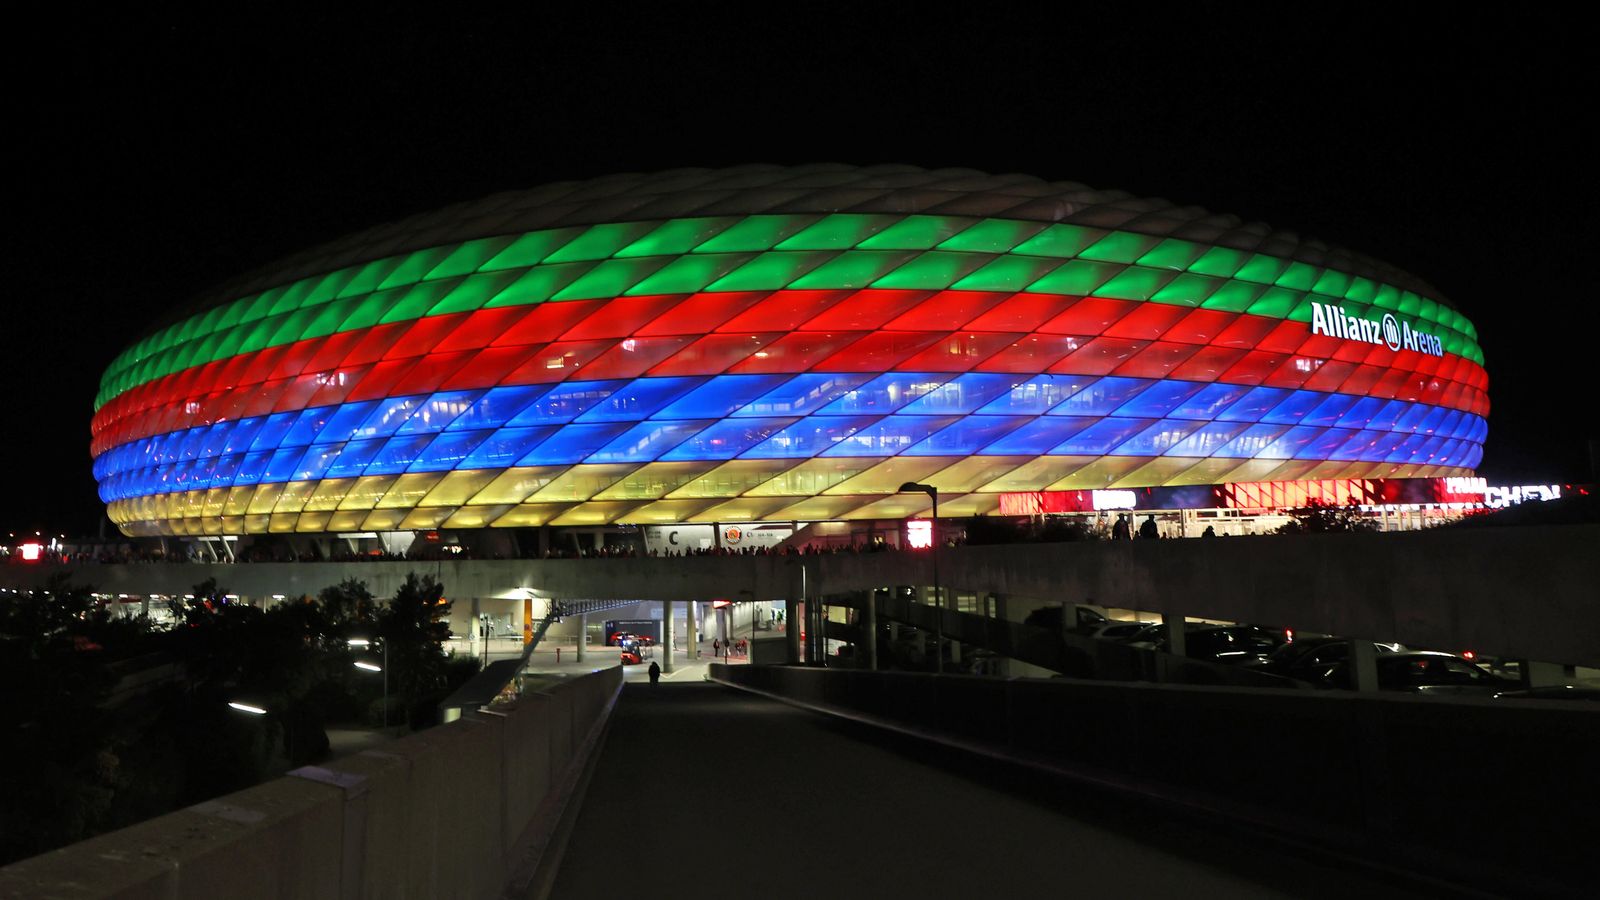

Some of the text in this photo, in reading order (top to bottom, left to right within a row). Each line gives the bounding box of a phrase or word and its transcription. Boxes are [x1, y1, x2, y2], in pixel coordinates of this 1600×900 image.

[1311, 302, 1443, 357] Allianz Arena
[669, 531, 678, 545] C
